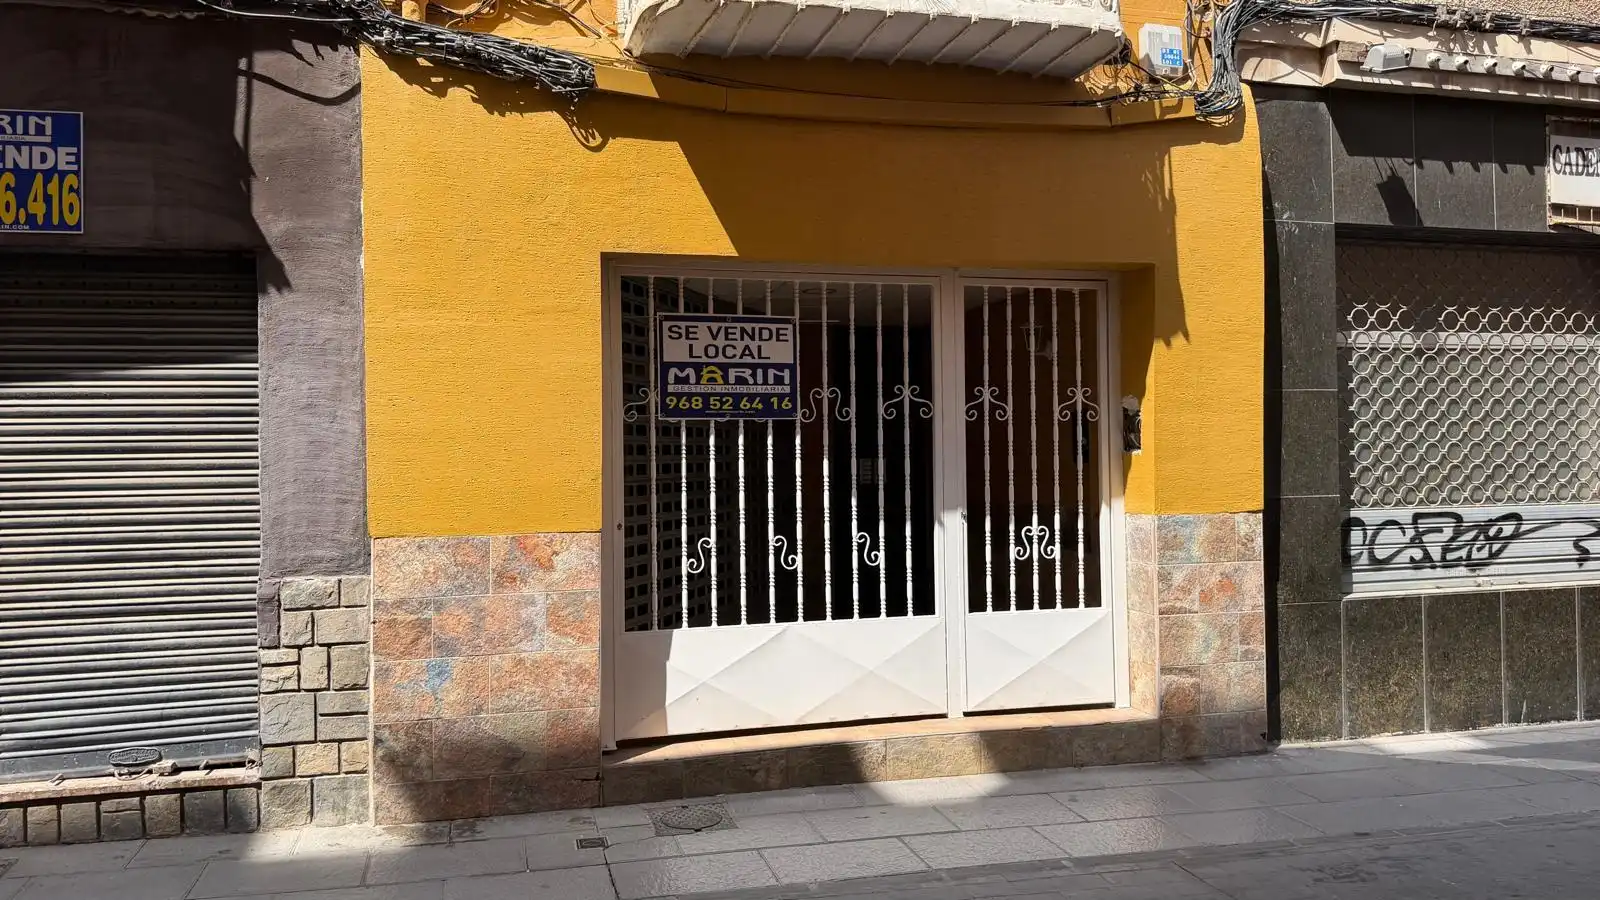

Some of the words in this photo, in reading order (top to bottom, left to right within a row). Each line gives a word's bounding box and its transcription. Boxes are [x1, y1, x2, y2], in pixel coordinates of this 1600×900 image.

[0, 145, 79, 171] NDE
[0, 171, 80, 226] 6.416
[667, 324, 700, 341] SE
[706, 325, 790, 343] VENDE
[688, 343, 771, 360] LOCAL
[667, 365, 790, 385] MARIN
[720, 385, 787, 393] INMOBILIARIA
[665, 396, 704, 410] 968
[709, 396, 734, 410] 52
[739, 397, 764, 411] 64
[770, 397, 793, 411] 16
